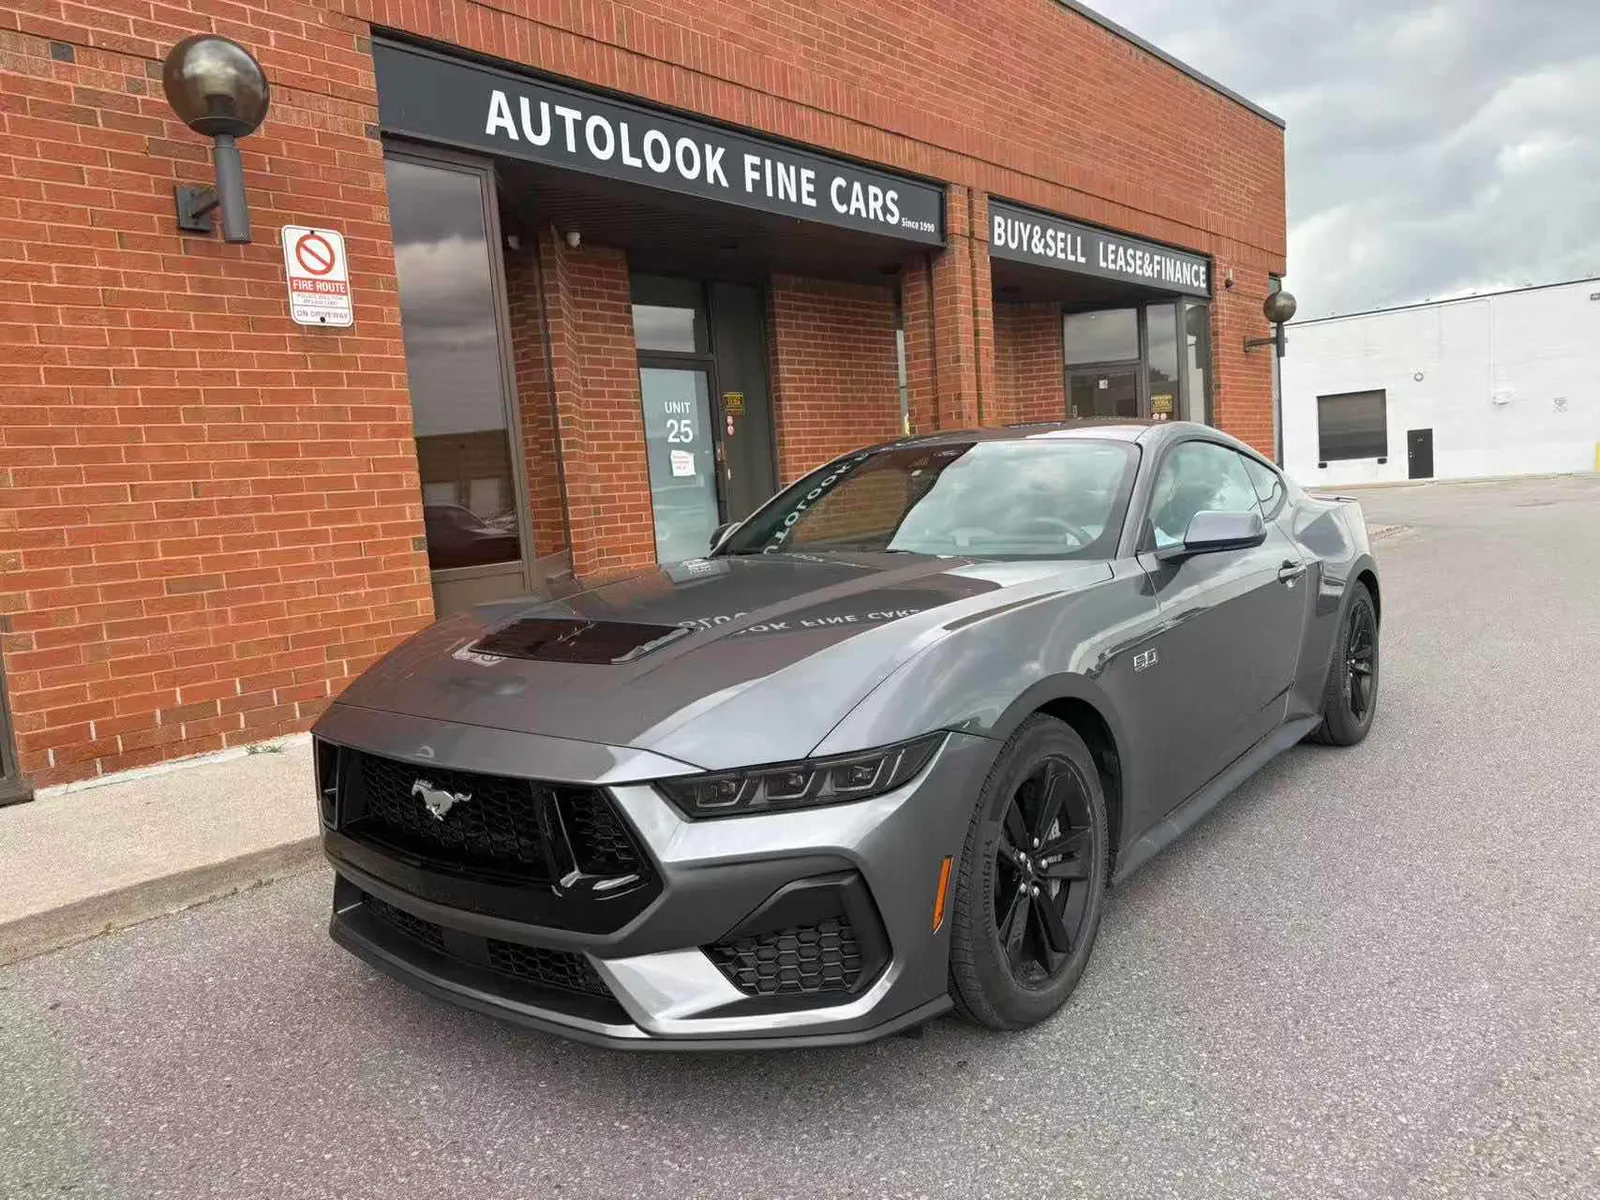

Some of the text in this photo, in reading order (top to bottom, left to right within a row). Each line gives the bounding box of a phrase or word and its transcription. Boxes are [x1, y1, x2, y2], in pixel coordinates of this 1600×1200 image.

[485, 89, 900, 226] AUTOLOOK FINE CARS
[901, 217, 919, 230] Since
[993, 215, 1207, 289] BUY&SELL LEASE&FINANCE
[293, 280, 346, 293] FIRE ROUTE
[664, 401, 691, 414] UNIT
[666, 419, 694, 443] 25
